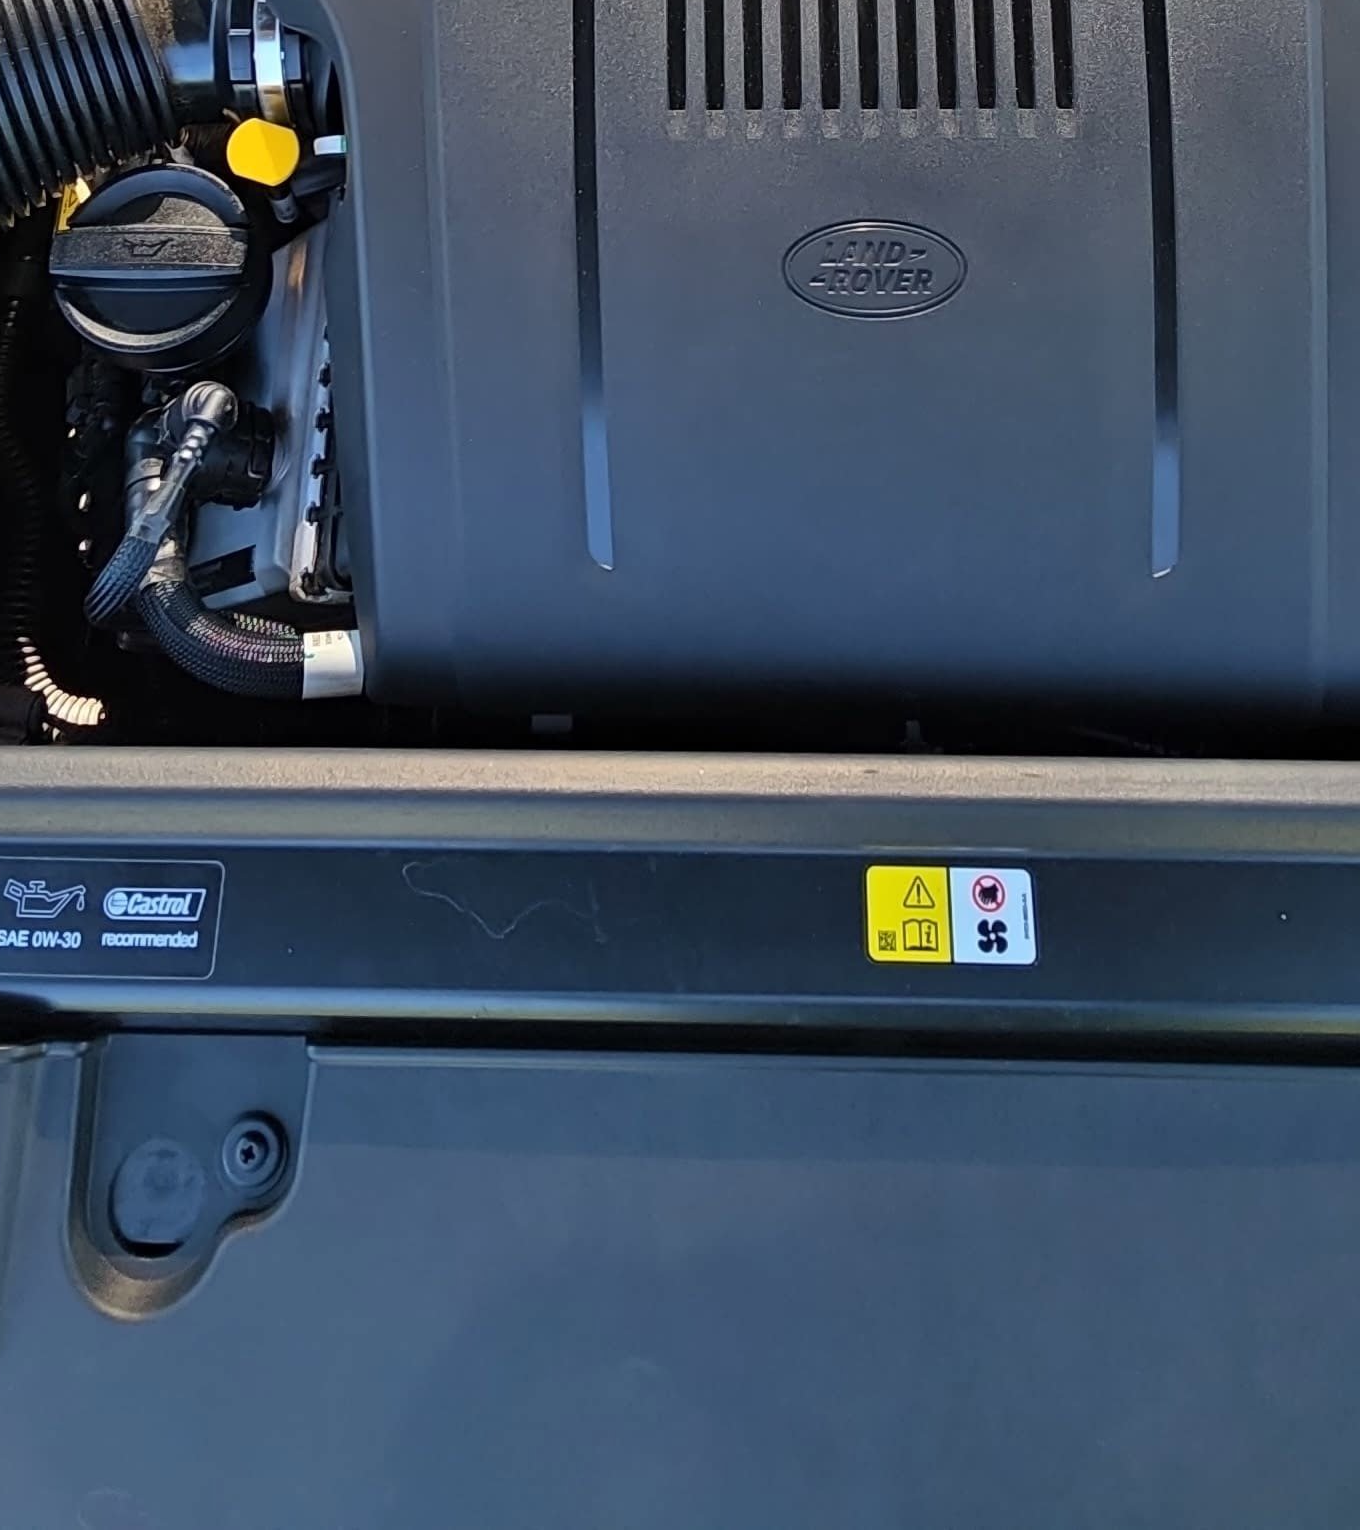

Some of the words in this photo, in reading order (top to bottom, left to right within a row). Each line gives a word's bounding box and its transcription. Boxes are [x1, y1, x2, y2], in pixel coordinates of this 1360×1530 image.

[819, 241, 906, 267] LAND
[827, 269, 934, 295] ROVER
[127, 892, 192, 916] Castrol
[31, 930, 82, 949] 0W-30
[101, 930, 199, 948] recommended
